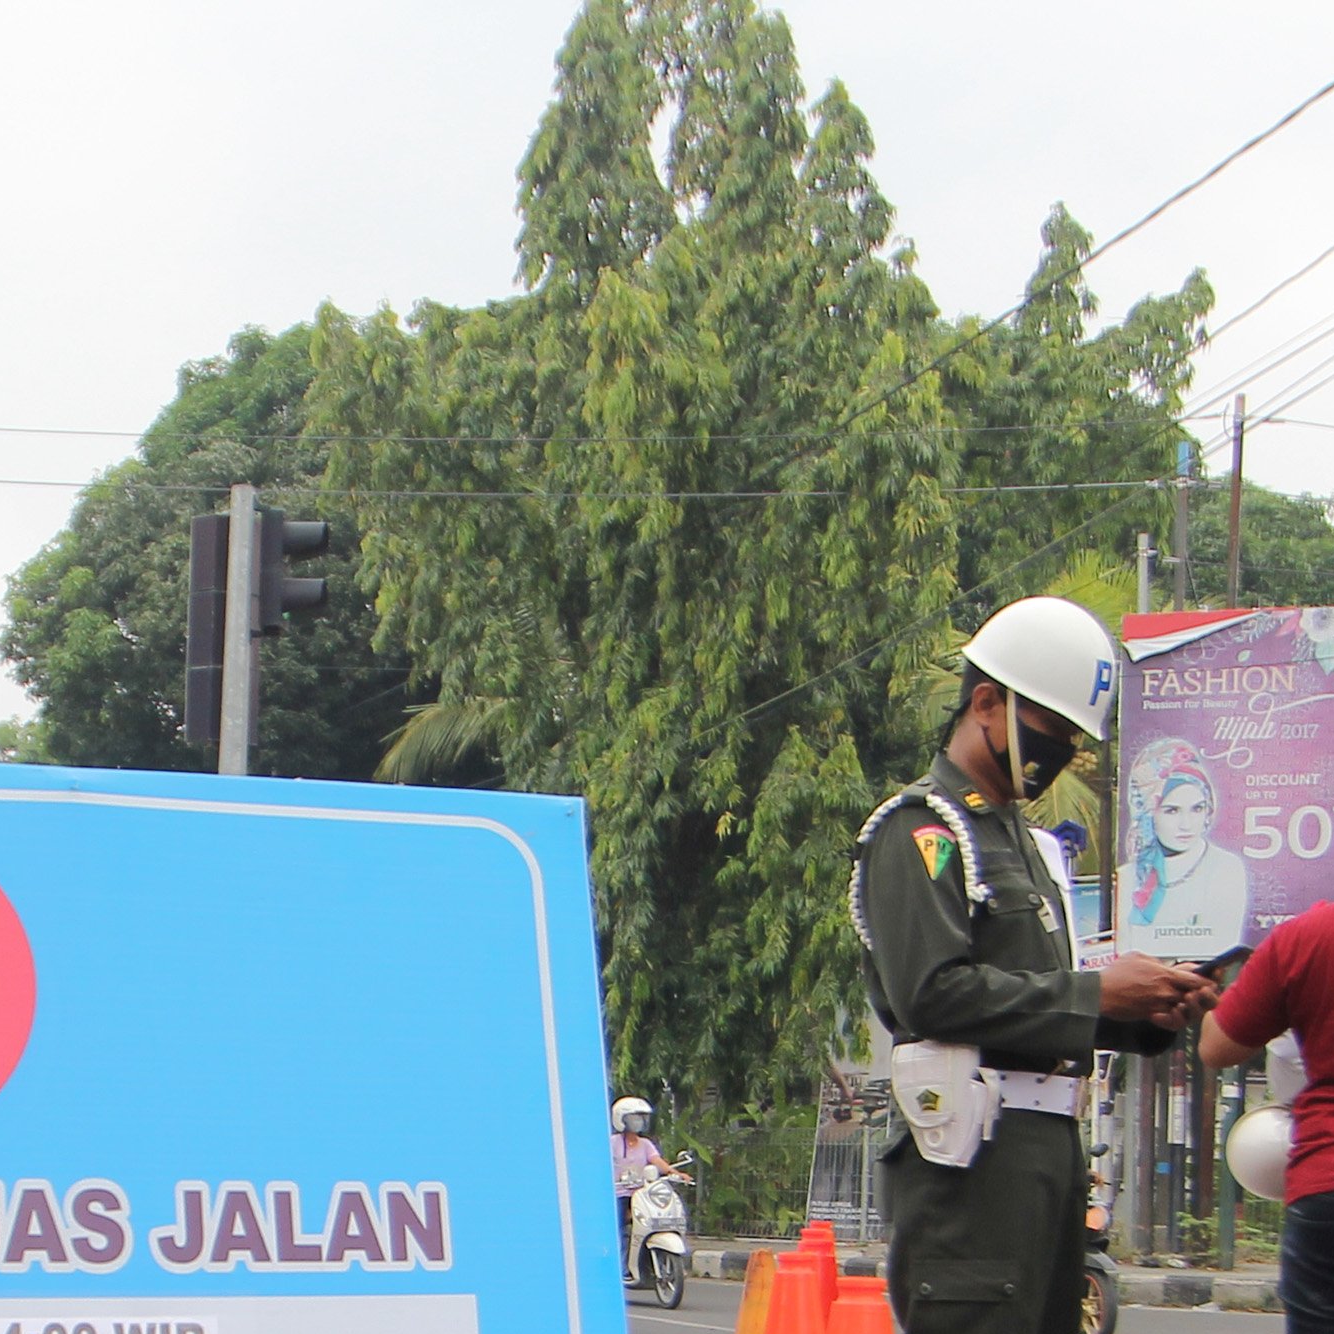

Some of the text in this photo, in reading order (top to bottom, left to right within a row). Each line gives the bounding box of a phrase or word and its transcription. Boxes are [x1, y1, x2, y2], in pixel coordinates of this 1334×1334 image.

[1141, 666, 1297, 697] FASHION
[1143, 700, 1183, 710] Passion
[1184, 699, 1201, 709] for
[1280, 723, 1320, 740] 2017
[1245, 773, 1321, 787] DISCOUNT
[1245, 790, 1277, 800] UP TO
[1154, 920, 1213, 939] junction
[156, 1188, 447, 1266] JALAN
